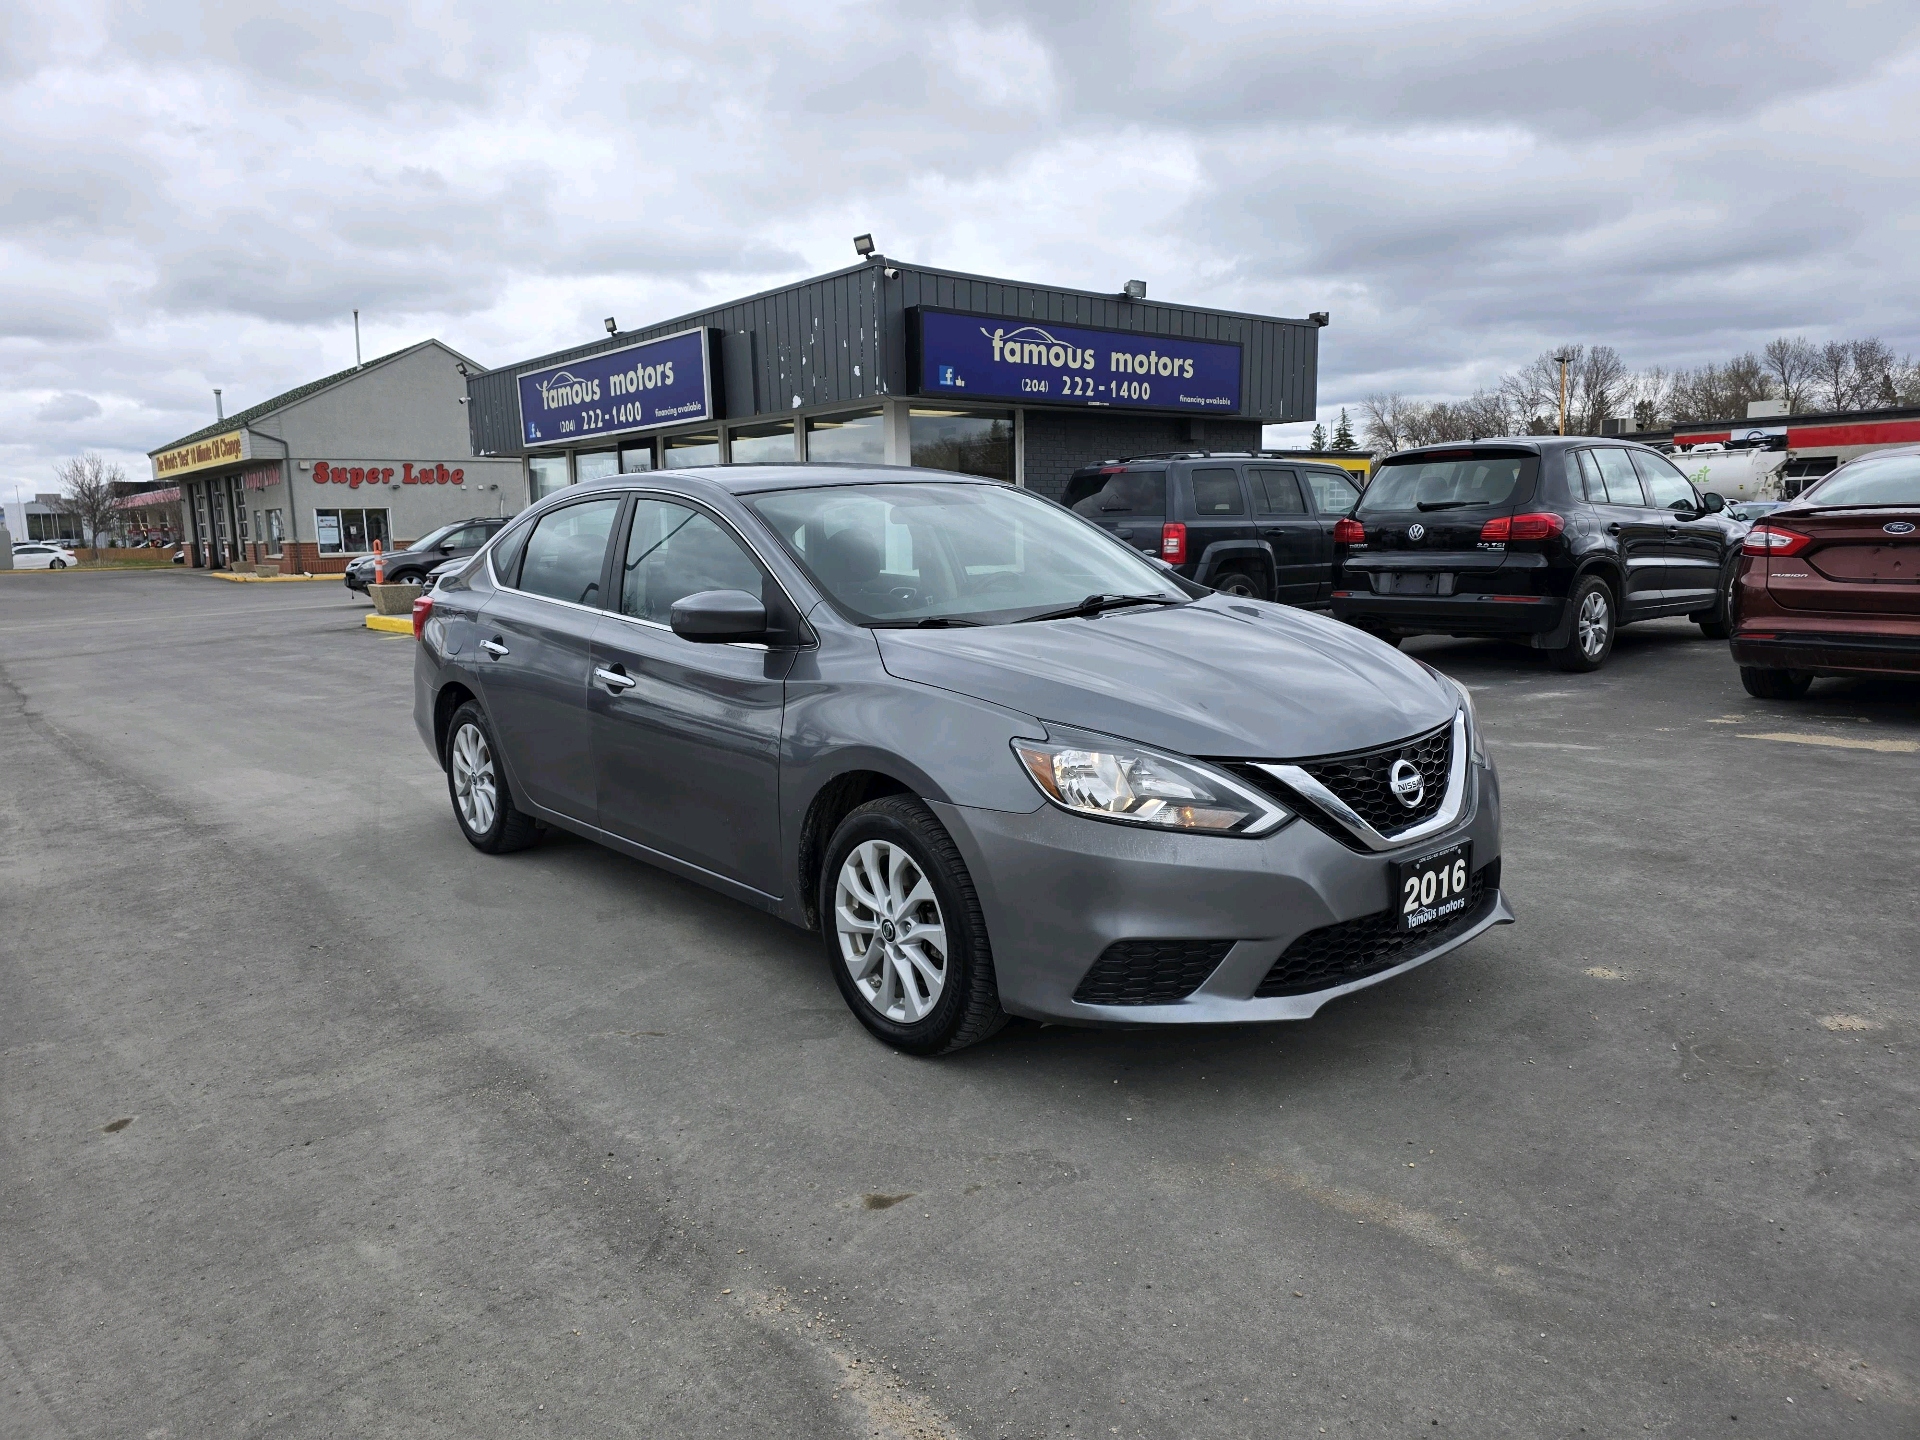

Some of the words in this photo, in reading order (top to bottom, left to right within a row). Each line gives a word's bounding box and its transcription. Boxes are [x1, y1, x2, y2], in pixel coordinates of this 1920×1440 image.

[993, 329, 1095, 370] famous
[1111, 350, 1194, 379] motors
[542, 377, 601, 410] famous
[610, 361, 674, 397] motors
[1021, 378, 1049, 393] (204)
[1062, 375, 1150, 400] 222-1400
[655, 403, 678, 418] financing
[677, 400, 702, 414] available
[1179, 394, 1205, 406] financing
[1206, 396, 1231, 406] available
[560, 419, 576, 433] (204)
[582, 401, 642, 430] 222-1400
[220, 437, 242, 460] Change
[312, 461, 395, 489] Super
[402, 462, 464, 485] Lube
[1688, 471, 1710, 483] GFL
[1403, 858, 1466, 914] 2016
[1407, 907, 1437, 929] famous
[1438, 897, 1465, 917] motors
